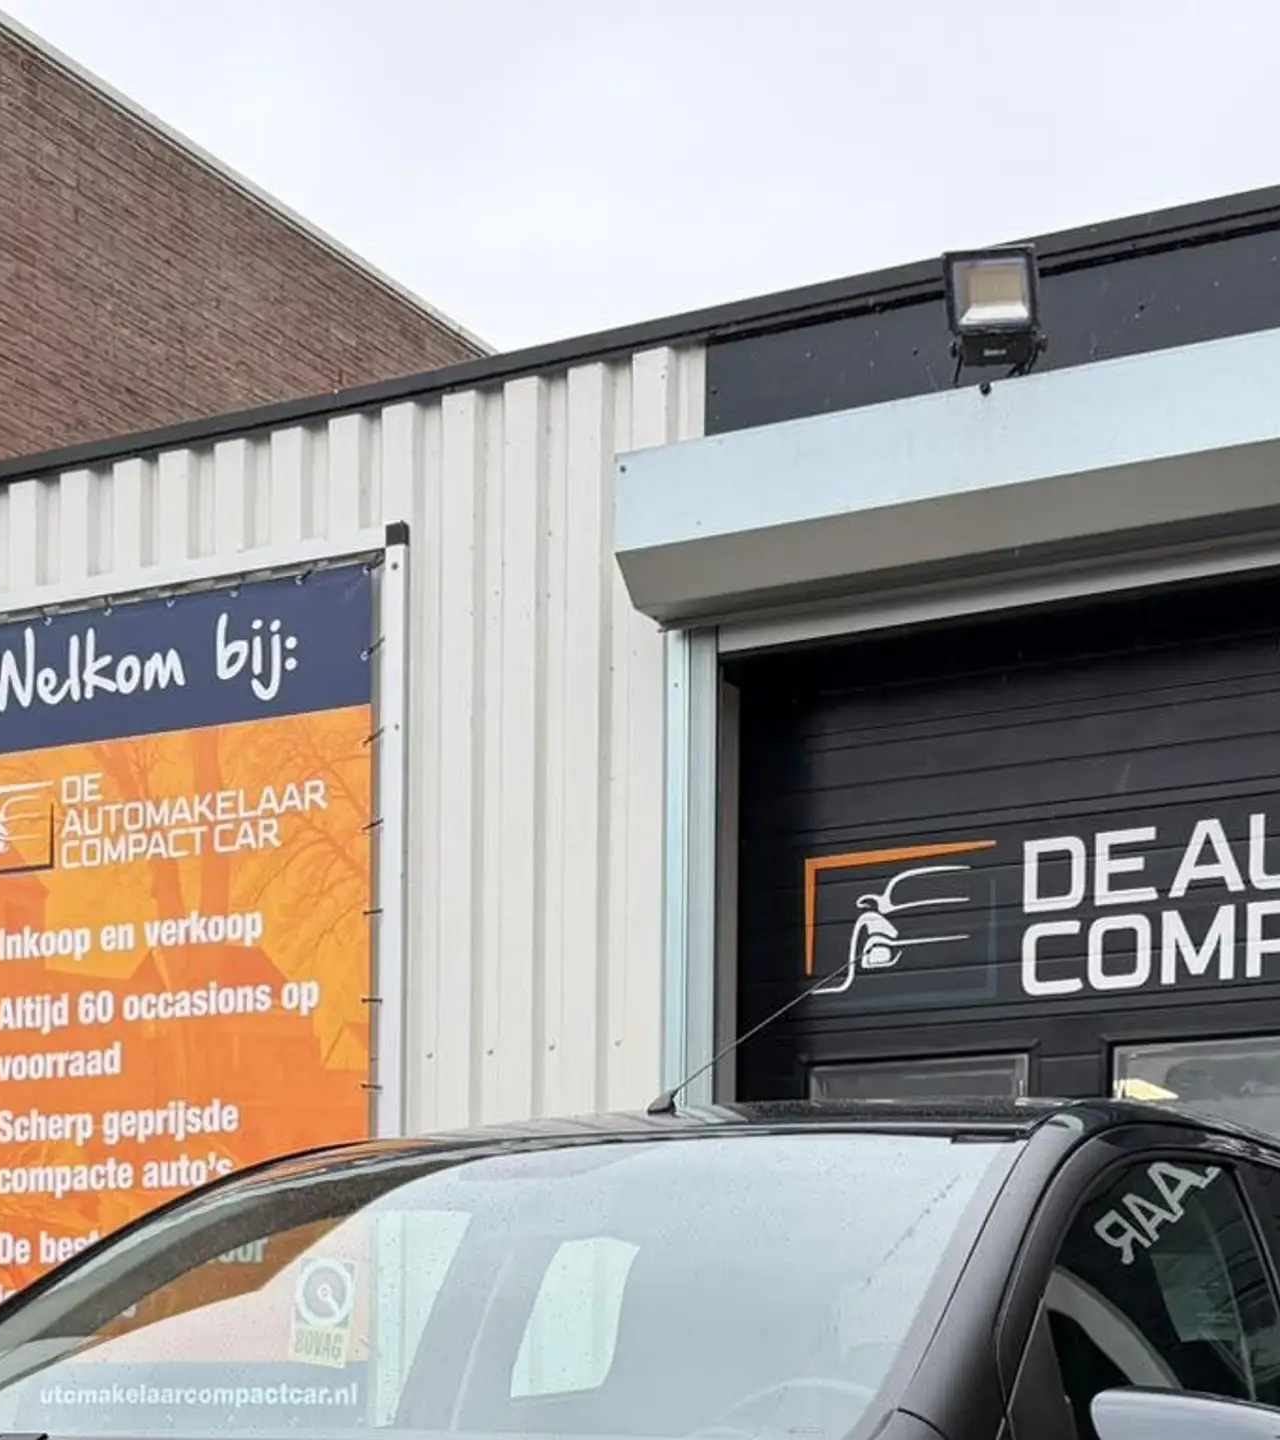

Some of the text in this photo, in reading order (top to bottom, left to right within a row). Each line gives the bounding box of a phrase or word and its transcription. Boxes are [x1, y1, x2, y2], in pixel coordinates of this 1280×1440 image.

[216, 613, 299, 701] bij:
[60, 773, 104, 804] DE
[60, 780, 329, 838] AUTOMAKELAAR
[61, 819, 282, 869] COMPACT CAR
[1022, 826, 1159, 914] DE
[100, 922, 135, 951] en
[144, 910, 263, 947] verkoop
[77, 990, 115, 1025] 60
[122, 981, 273, 1022] occasions
[281, 980, 320, 1017] op
[103, 1099, 239, 1145] geprijsde
[294, 1329, 343, 1361] BOVAG
